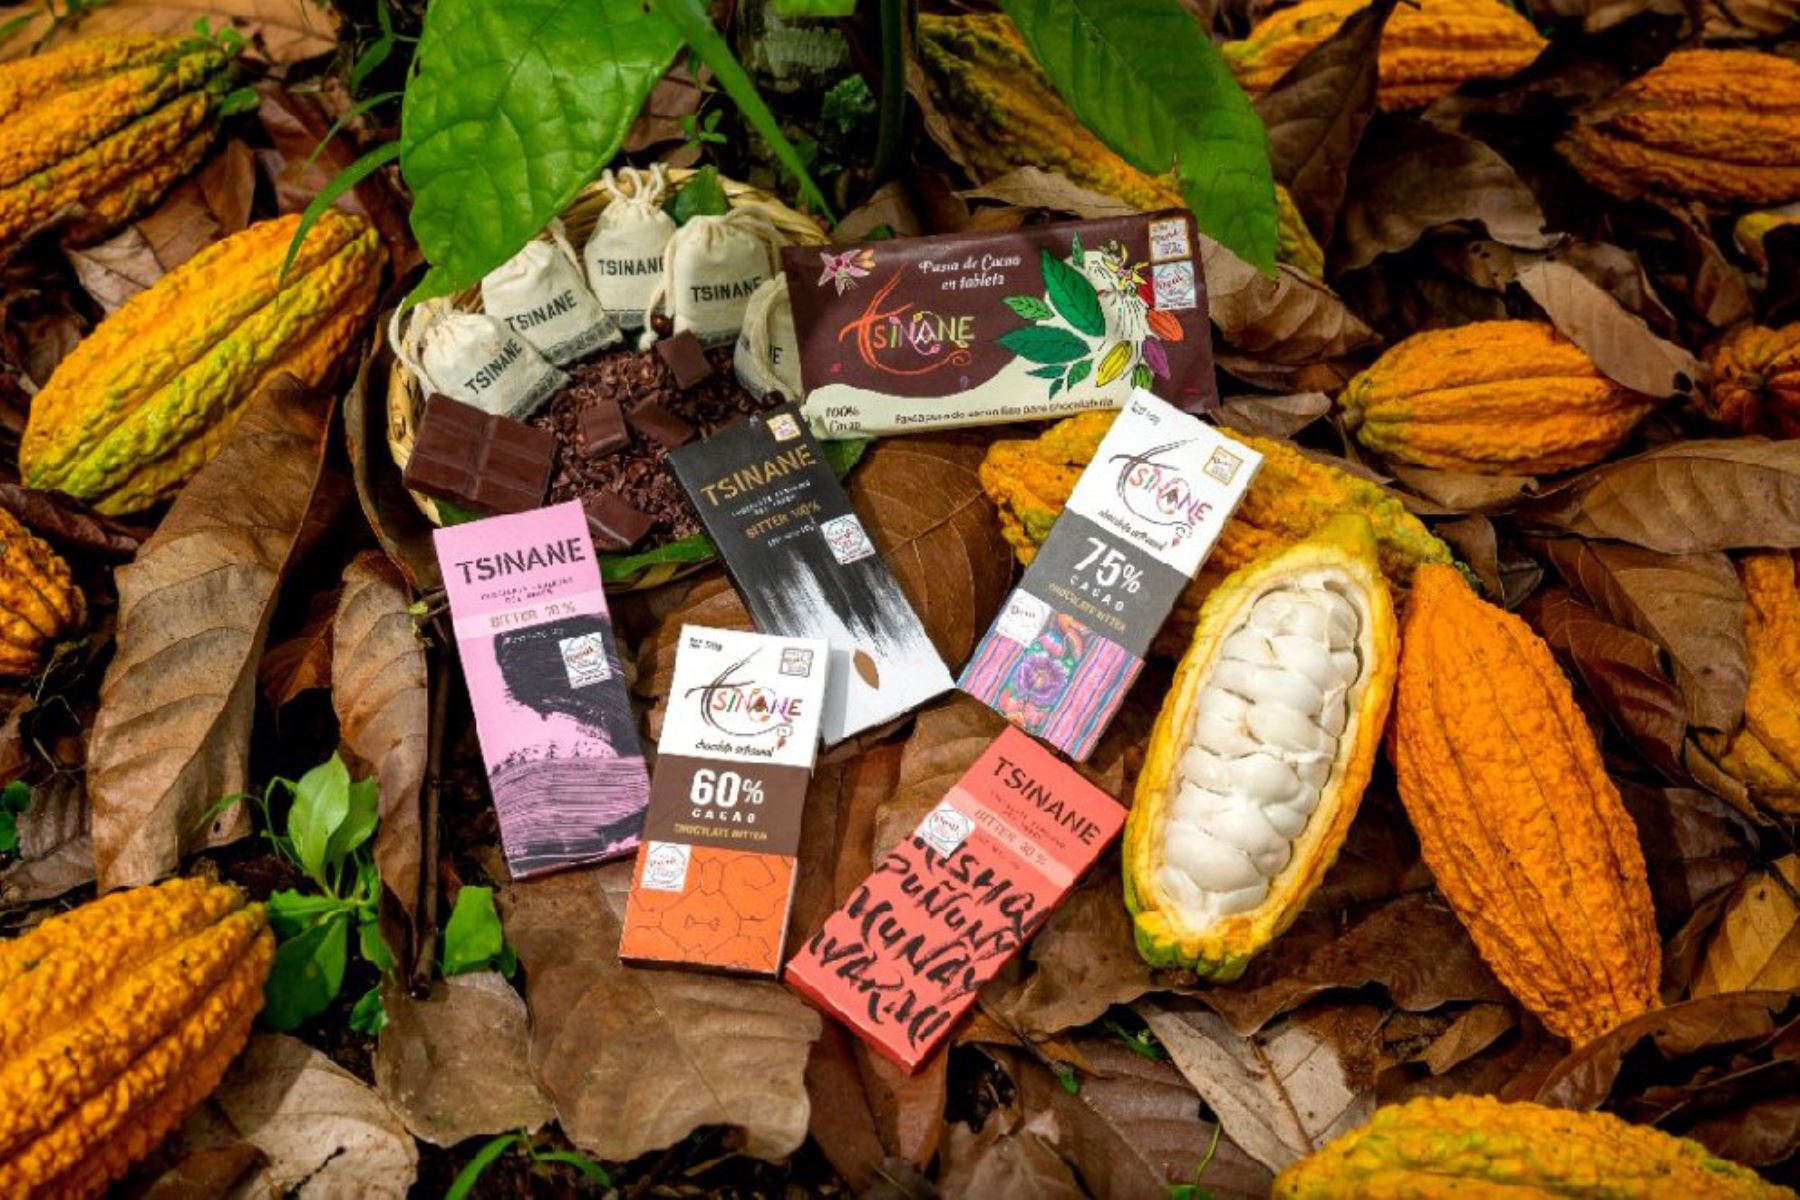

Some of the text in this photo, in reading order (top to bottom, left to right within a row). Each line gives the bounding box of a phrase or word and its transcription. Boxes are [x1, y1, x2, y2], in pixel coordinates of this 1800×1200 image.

[963, 255, 978, 270] de
[504, 288, 579, 332] TSINANE
[464, 336, 523, 395] TSINANE
[700, 443, 818, 507] TSINANE
[745, 513, 789, 540] BITTER
[455, 537, 586, 585] TSINANE
[1073, 537, 1144, 594] 75%
[1069, 574, 1124, 612] CACAO
[490, 609, 538, 628] BITTER
[690, 768, 765, 808] 60%
[993, 756, 1102, 846] TSINANE
[673, 823, 769, 841] CHOCOLATE BITTER
[691, 808, 756, 824] CACAO
[974, 809, 1018, 842] BITTER
